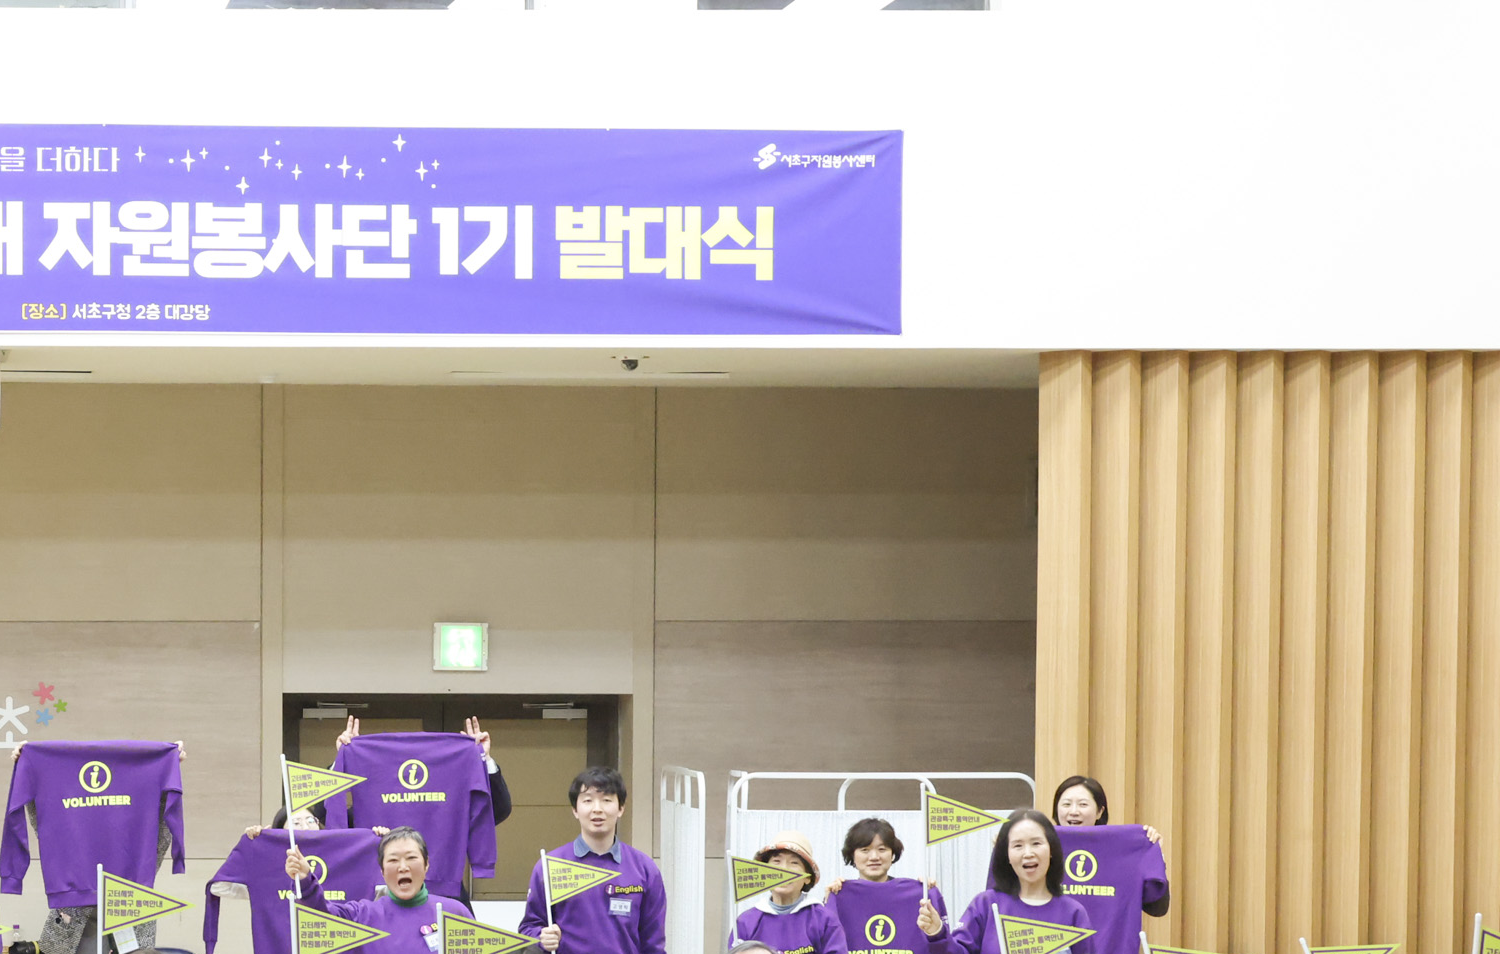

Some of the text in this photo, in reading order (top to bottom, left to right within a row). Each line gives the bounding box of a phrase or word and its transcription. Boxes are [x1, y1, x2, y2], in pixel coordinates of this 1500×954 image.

[37, 147, 120, 172] 더하다
[781, 154, 875, 168] 서초구자원봉사센터
[39, 201, 417, 278] 자원봉사단
[432, 205, 533, 279] 1기
[556, 206, 774, 280] 발대식
[22, 303, 210, 320] [장소] 서초구청 2층 대강당
[62, 795, 131, 808] VOLUNTEER
[382, 792, 447, 803] VOLUNTEER
[107, 889, 134, 898] 고터세빛
[615, 885, 643, 894] English
[1062, 884, 1116, 897] LUNTEER
[278, 890, 346, 900] VOEER
[107, 899, 163, 908] 관광특구 통역안내
[106, 908, 140, 917] 자원봉사단
[300, 921, 327, 929] 고터세빛
[301, 930, 356, 938] 관광특구 통역안내
[301, 940, 334, 948] 자원봉사단
